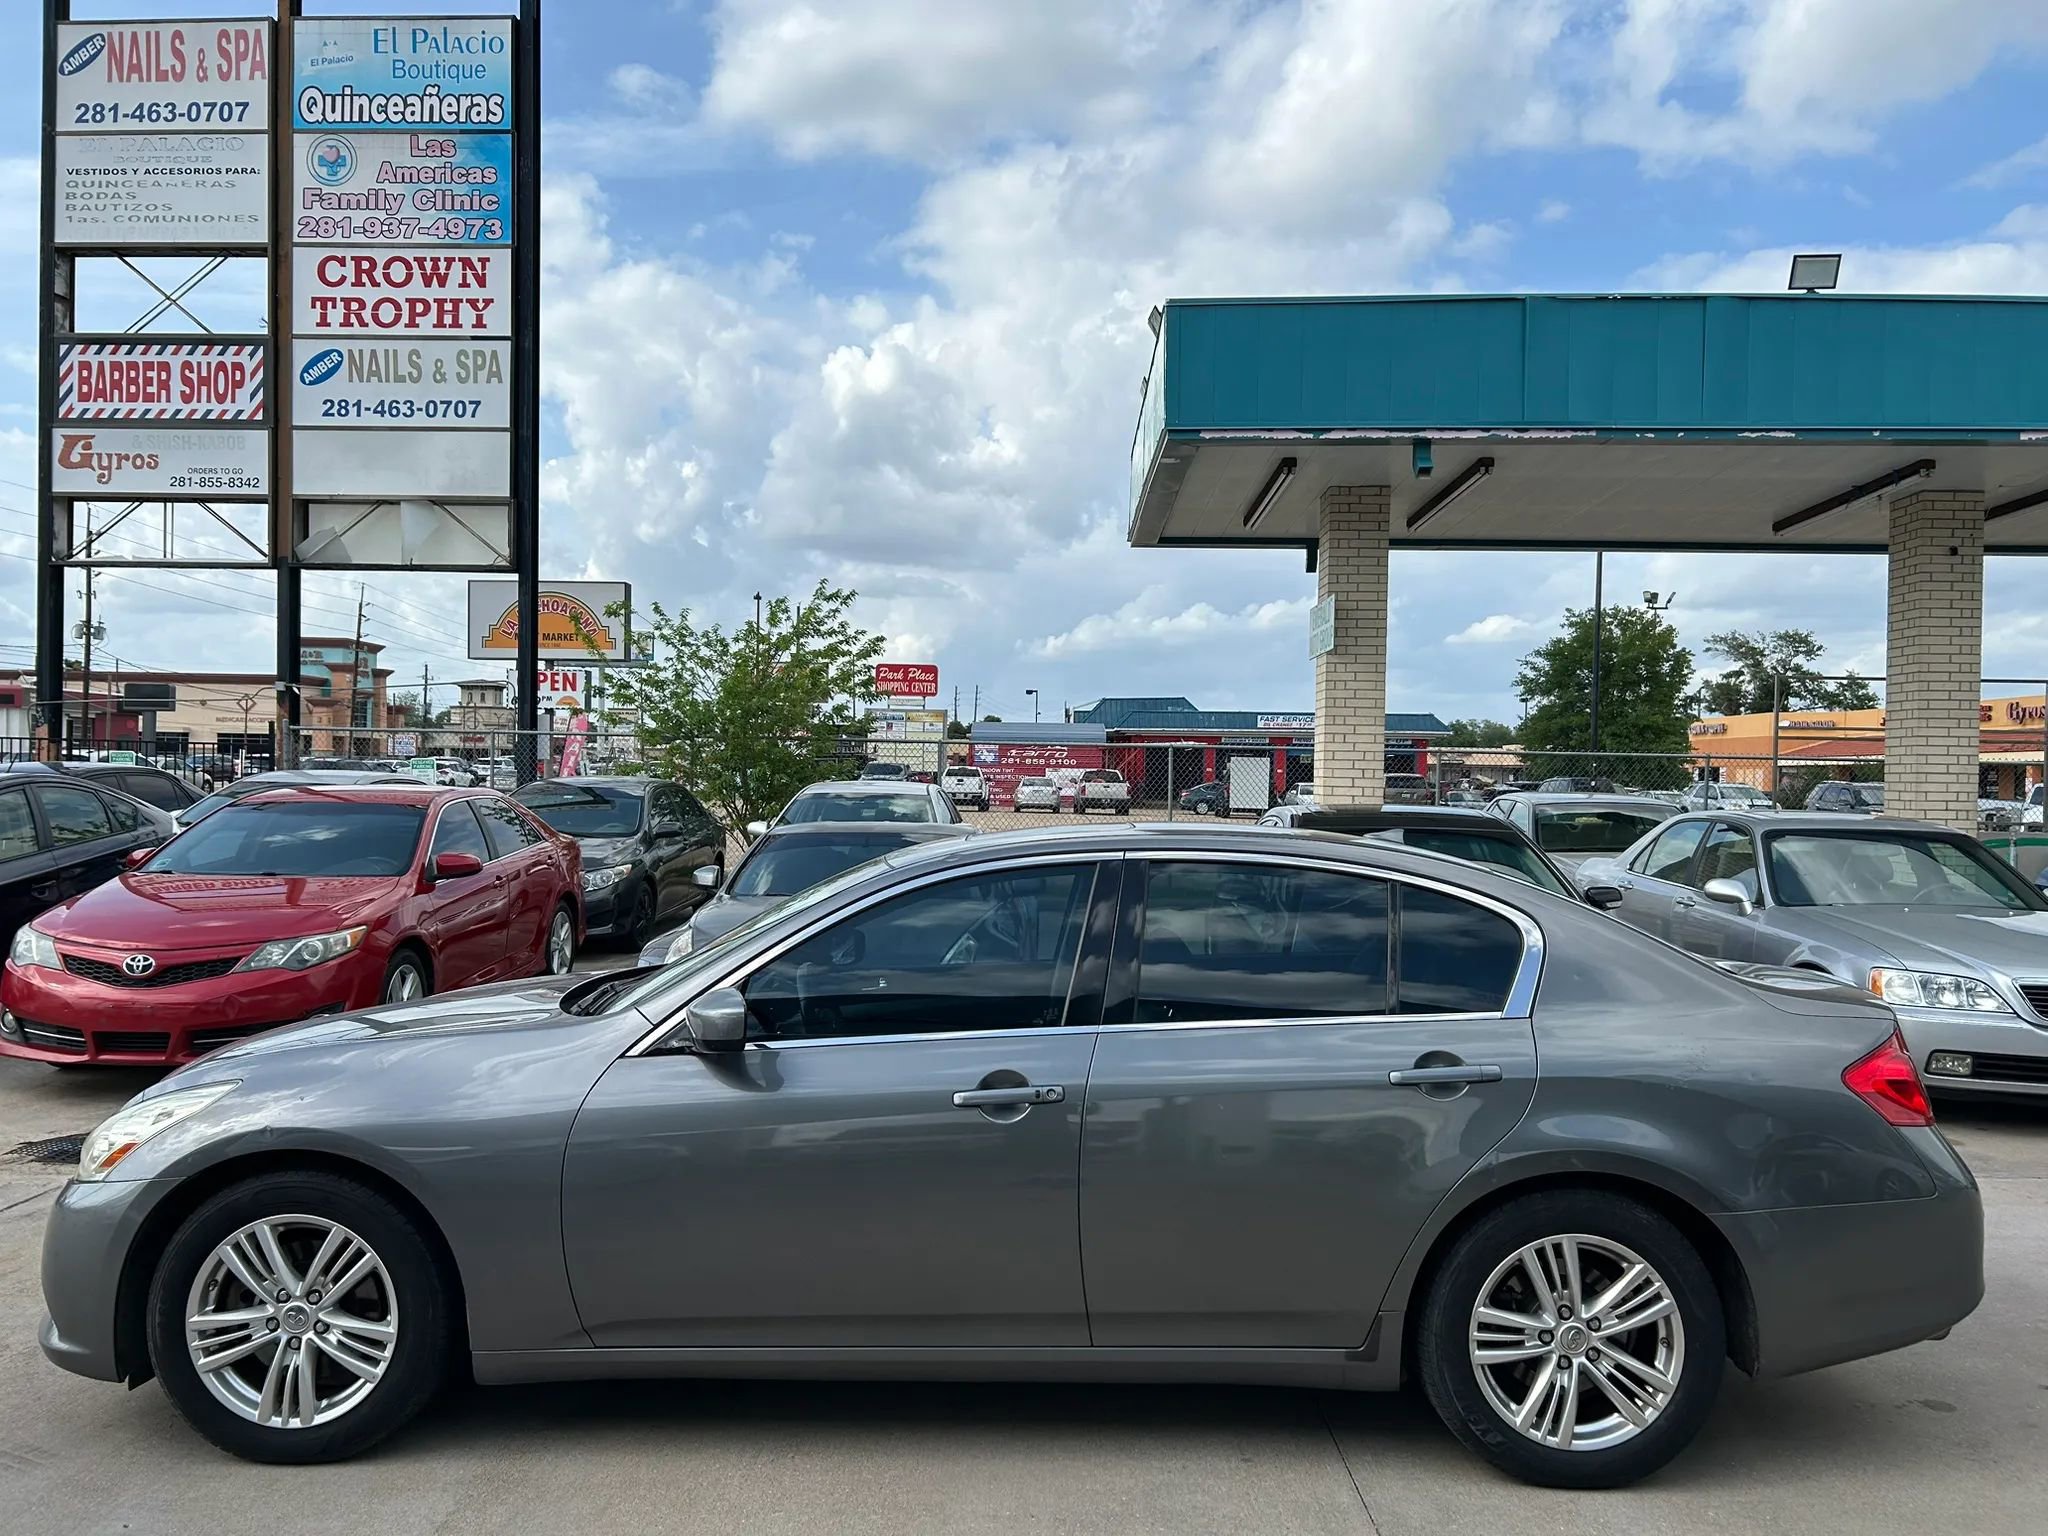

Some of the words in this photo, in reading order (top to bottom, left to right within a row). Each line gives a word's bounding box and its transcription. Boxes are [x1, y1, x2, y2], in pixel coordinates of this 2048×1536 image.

[373, 27, 398, 54] El
[62, 34, 105, 75] AMBER
[106, 30, 187, 83] NAILS
[196, 48, 208, 83] &
[216, 29, 267, 82] SPA
[310, 58, 320, 67] El
[321, 54, 354, 67] Palacio
[392, 59, 487, 83] Boutique
[75, 101, 249, 123] 281-463-0707
[299, 84, 505, 125] Quinceañeras
[120, 137, 245, 151] PALACIO
[410, 135, 456, 158] Las
[114, 156, 213, 164] BOUTIQUE
[66, 168, 127, 176] VESTIDOS
[144, 167, 222, 176] ACCESORIOS
[225, 167, 261, 175] PARA:
[376, 161, 498, 184] Americas
[65, 192, 136, 200] BODAS
[303, 188, 405, 216] Family
[412, 189, 500, 211] Clinic
[65, 203, 173, 212] BAUTIZOS
[113, 214, 260, 223] COMUNIONES
[298, 216, 502, 239] 281-937-4973
[317, 255, 490, 289] CROWN
[311, 297, 494, 329] TROPHY
[302, 351, 343, 385] AMBER
[347, 349, 423, 384] NAILS
[432, 358, 447, 384] &
[456, 349, 503, 384] SPA
[77, 360, 171, 404] BARBER
[179, 360, 246, 405] SHOP
[322, 399, 482, 418] 281-463-0707
[58, 434, 159, 485] Gyros
[187, 467, 218, 475] ORDERS
[170, 476, 260, 489] 281-855-8342
[500, 617, 518, 639] LA
[542, 632, 579, 641] MARKET
[538, 672, 577, 692] PEN
[879, 667, 904, 680] Park
[908, 668, 935, 681] Place
[877, 681, 909, 693] SHOPPING
[911, 682, 936, 694] CENTER
